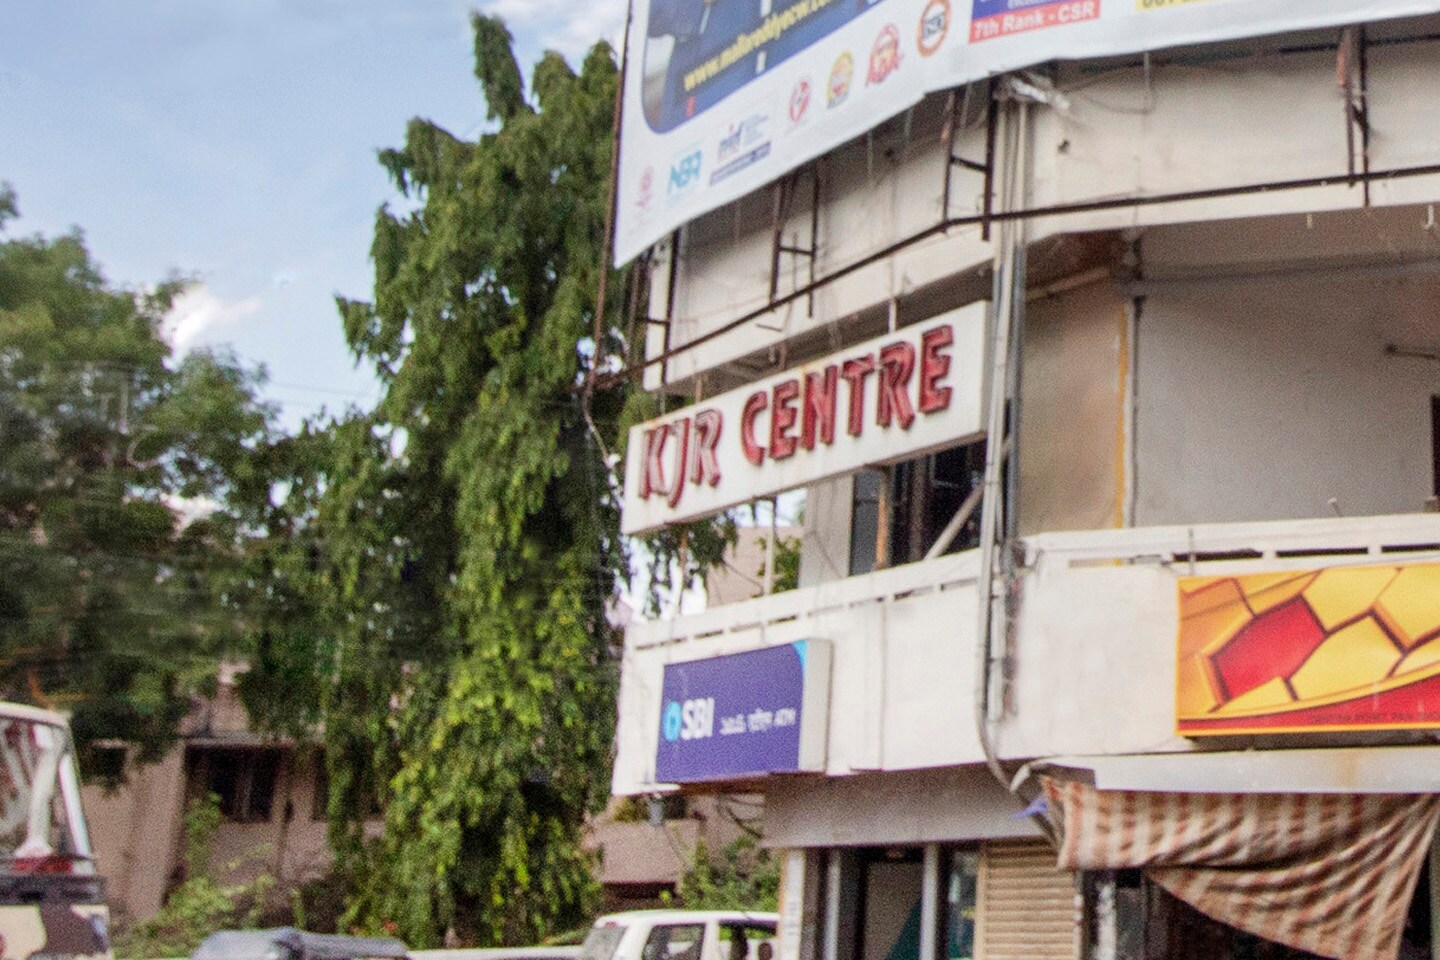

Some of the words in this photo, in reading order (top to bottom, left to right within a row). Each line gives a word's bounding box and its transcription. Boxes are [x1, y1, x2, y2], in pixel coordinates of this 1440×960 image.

[974, 20, 998, 40] 7th
[1002, 11, 1044, 31] Rank
[1057, 0, 1096, 22] CSR
[637, 407, 724, 508] KJR
[740, 324, 954, 465] CENTRE
[681, 697, 715, 740] SBI
